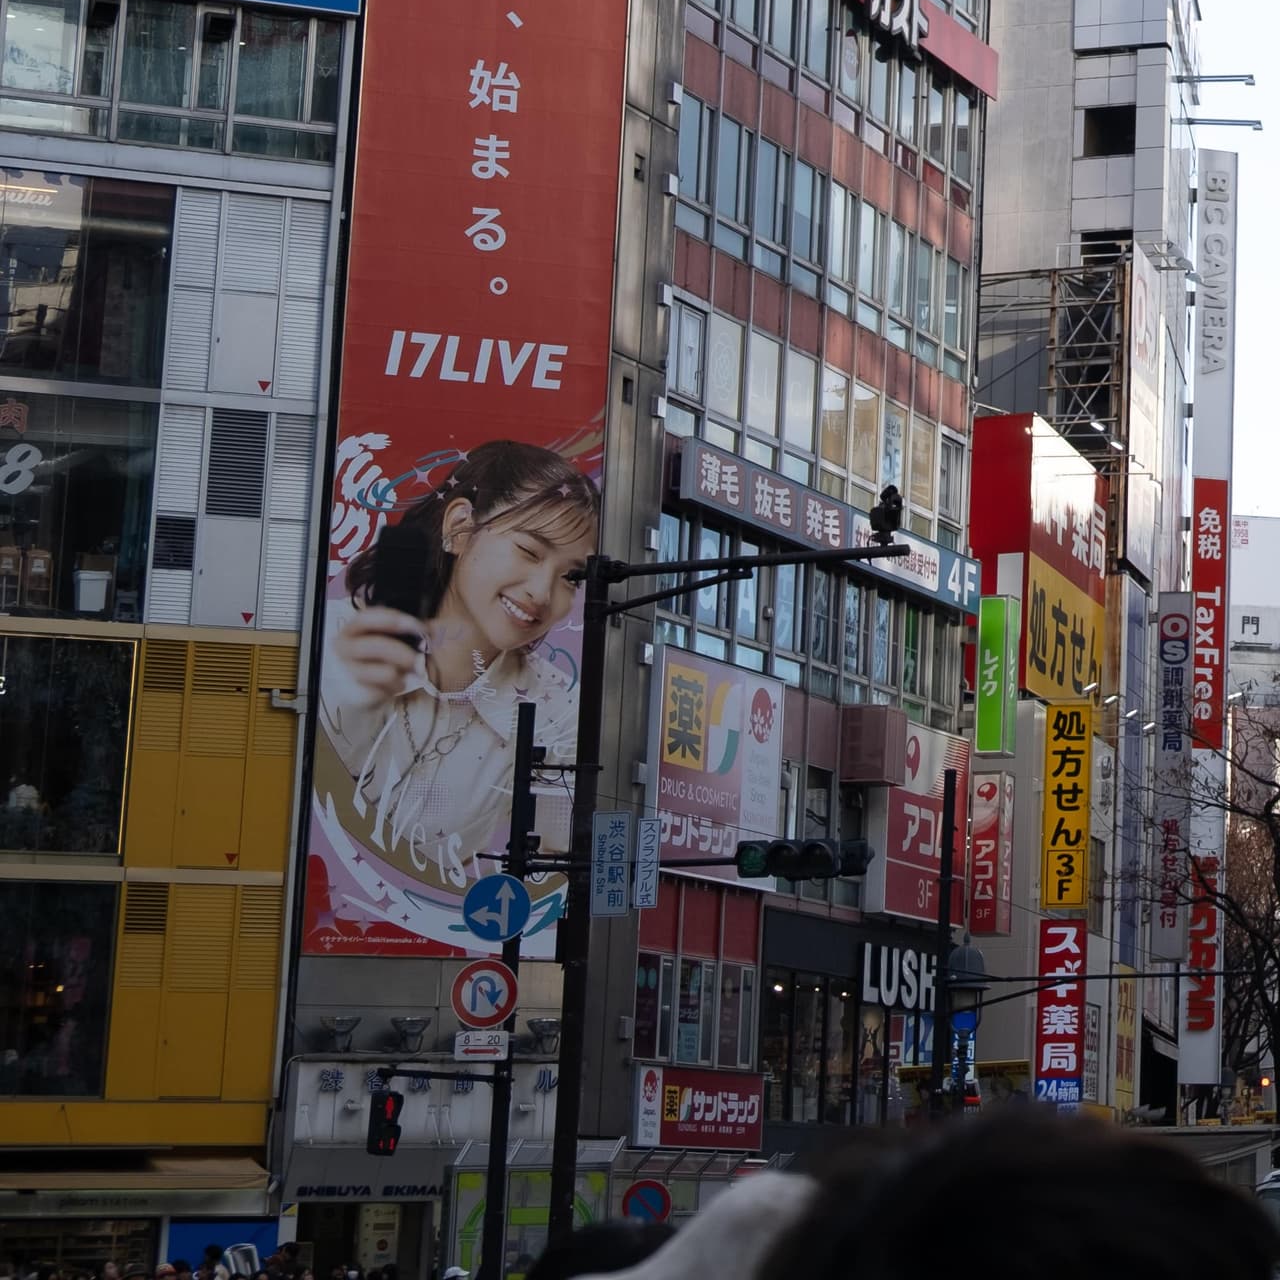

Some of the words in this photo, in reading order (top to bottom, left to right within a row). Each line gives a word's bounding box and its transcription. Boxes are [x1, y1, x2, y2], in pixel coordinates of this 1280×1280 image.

[1204, 170, 1229, 225] BIC
[1201, 233, 1228, 376] CAMERA
[806, 497, 841, 549] 発毛
[947, 558, 977, 606] 4F
[1198, 506, 1222, 560] 免税
[982, 648, 999, 697] レイク
[666, 673, 704, 761] 薬
[660, 777, 685, 800] DRUG
[695, 786, 738, 810] COSMETIC
[1050, 710, 1086, 847] 処方せん
[901, 803, 943, 858] アコ
[607, 820, 625, 907] 渋谷駅前
[639, 822, 657, 905] スクランブル式
[974, 838, 996, 901] アコム
[1055, 853, 1075, 901] 3F
[917, 879, 933, 909] 3F
[975, 908, 991, 920] 3F
[862, 941, 937, 1013] LUSH
[1040, 926, 1083, 1073] スギ薬局
[463, 1035, 471, 1045] 8
[487, 1034, 501, 1045] 20
[693, 1088, 760, 1124] サンドラッグ
[1037, 1079, 1058, 1102] 24
[297, 1185, 372, 1197] SHIBUYA
